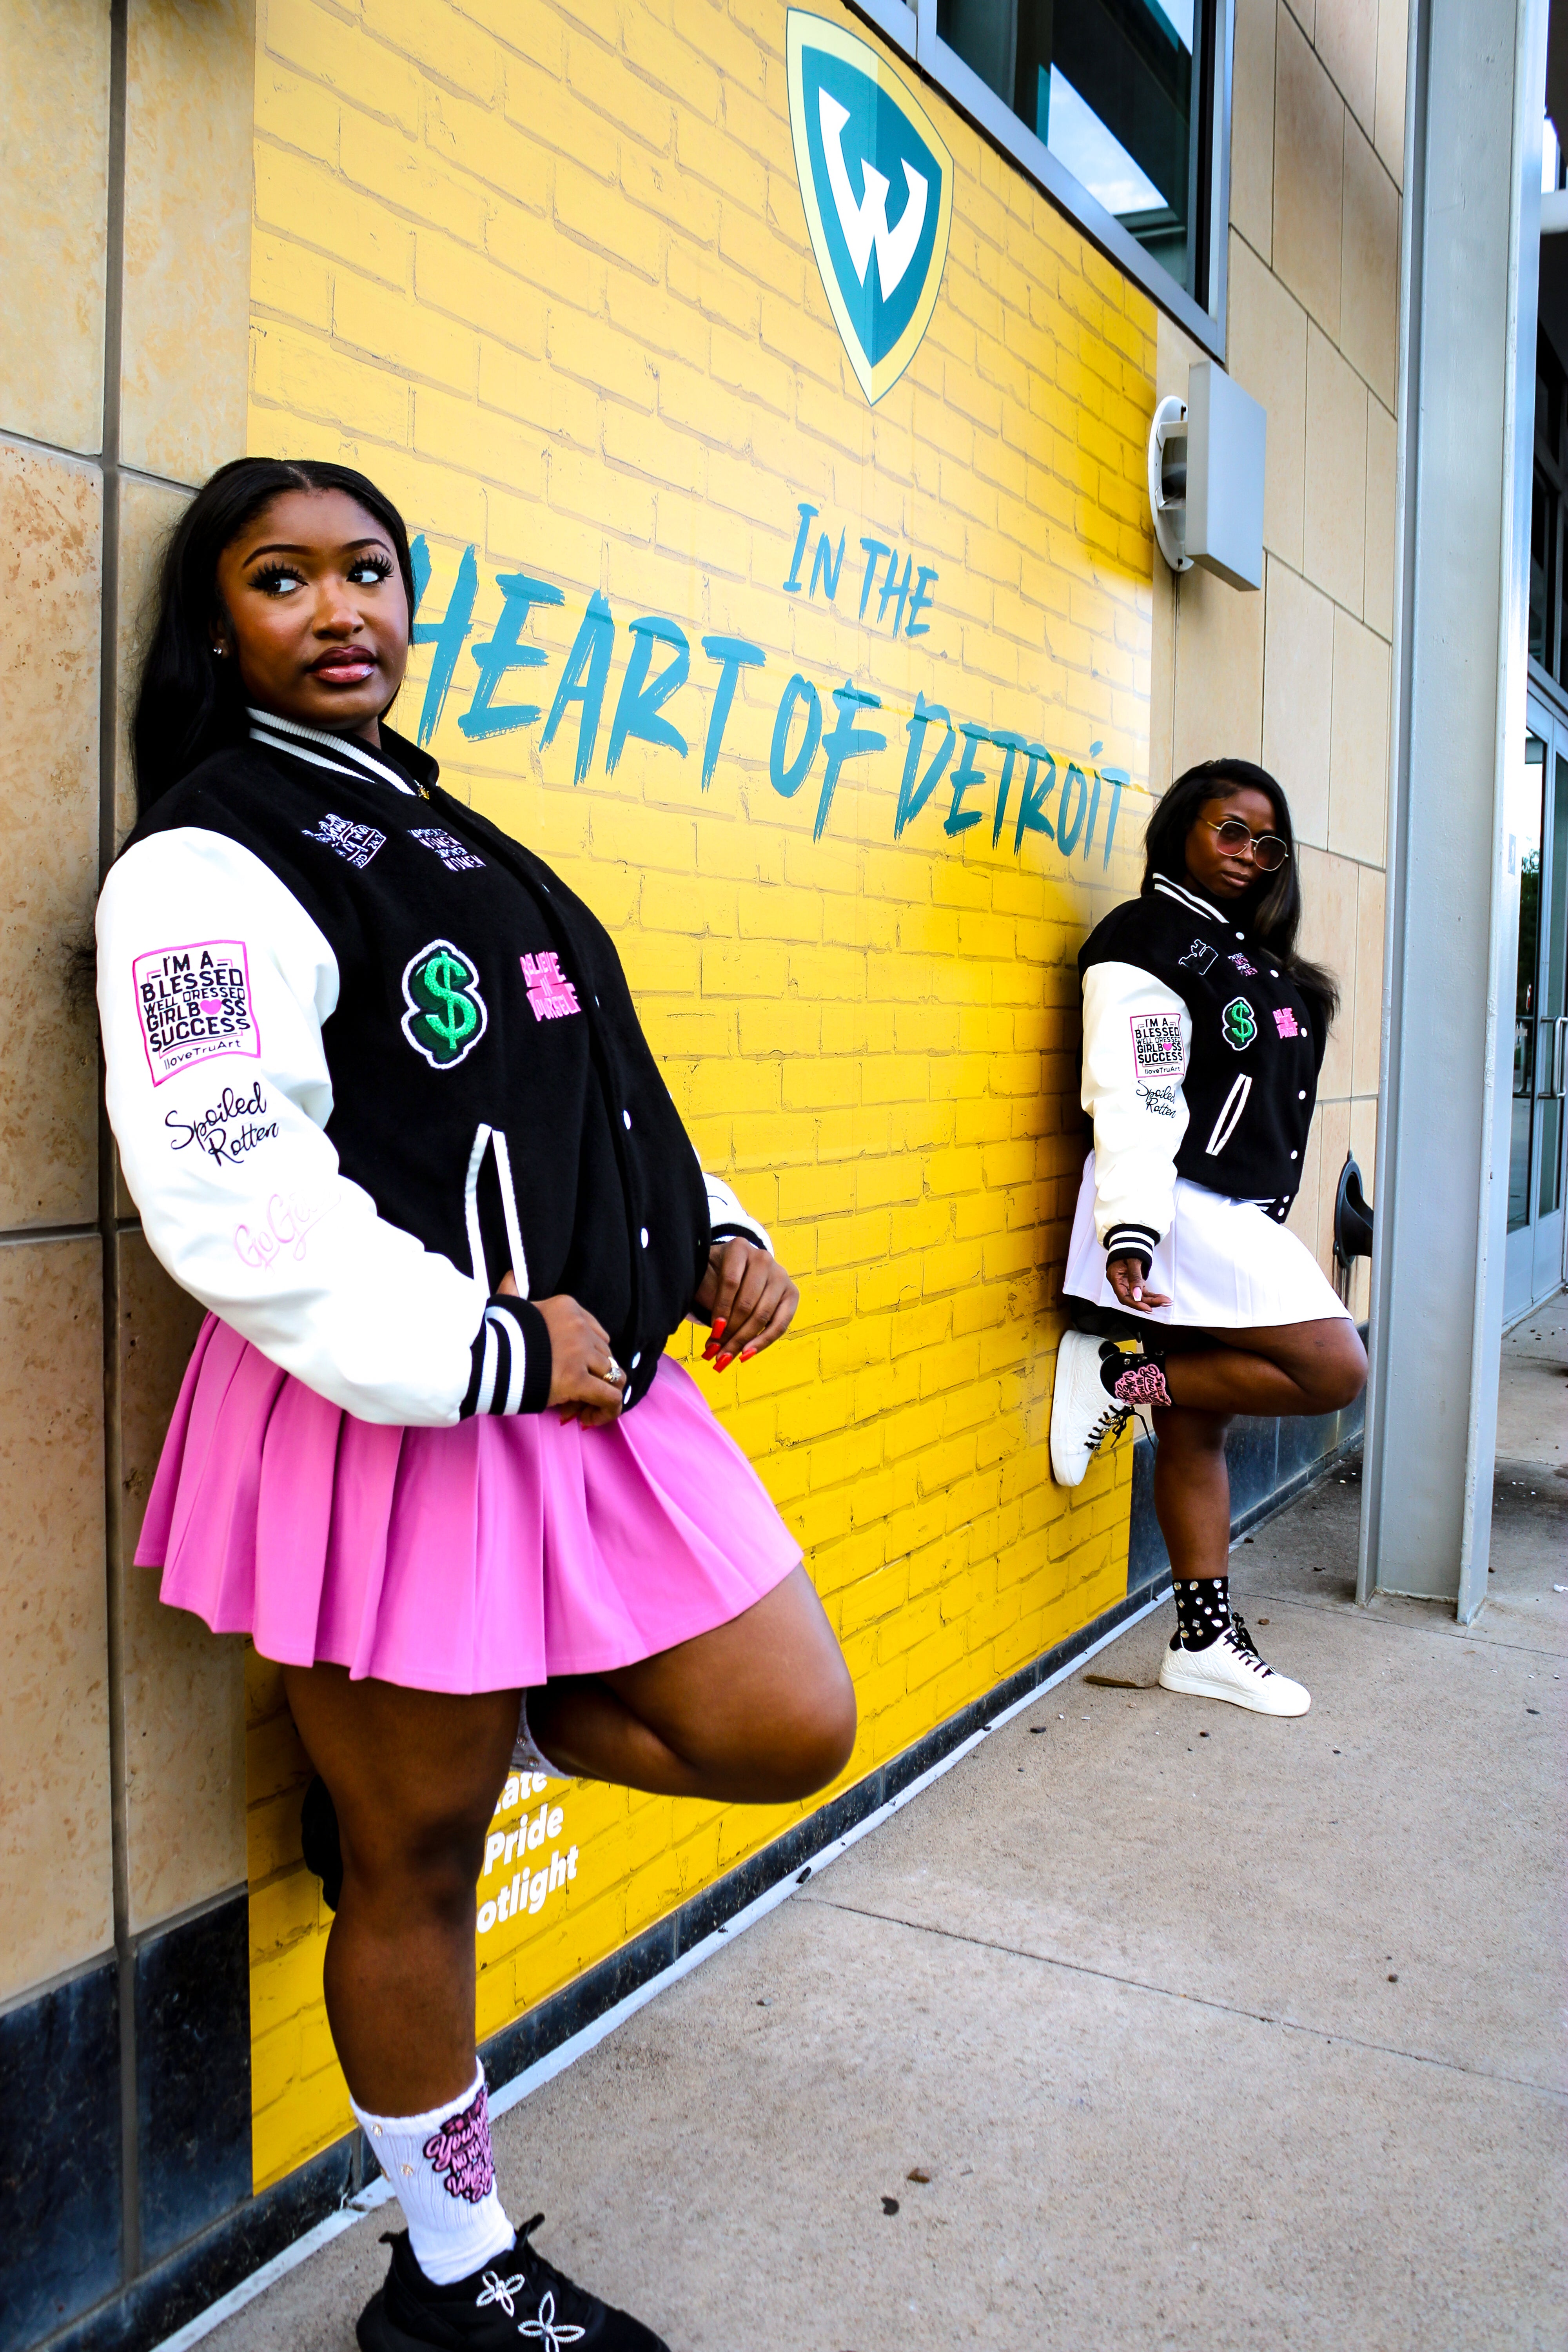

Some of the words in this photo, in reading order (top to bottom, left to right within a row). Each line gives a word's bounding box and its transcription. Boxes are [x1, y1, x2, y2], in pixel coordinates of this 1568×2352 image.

[782, 503, 846, 601] IN
[858, 537, 939, 639] THE
[410, 534, 767, 795] HEART
[769, 673, 888, 845] OF
[443, 855, 486, 871] WOMEN
[163, 954, 191, 976] I'M
[200, 951, 214, 969] A
[520, 951, 566, 987] BELIEVE
[140, 969, 243, 1003] BLESSED
[526, 983, 582, 1022] YOURSELF
[143, 996, 178, 1016] WELL
[146, 998, 247, 1032] GIRLBSS
[1145, 1018, 1158, 1027] I'M
[1162, 1018, 1169, 1026] A
[150, 1016, 250, 1052] SUCCESS
[1134, 1027, 1180, 1038] BLESSED
[1137, 1042, 1182, 1053] GIRLBSS
[1138, 1052, 1183, 1063] SUCCESS
[1136, 1080, 1176, 1104] Spoiled
[1146, 1098, 1176, 1118] Rotten
[165, 1082, 266, 1152] Spoiled
[203, 1122, 279, 1167] Rotten
[494, 1771, 548, 1815] ate
[484, 1803, 564, 1877] Pride
